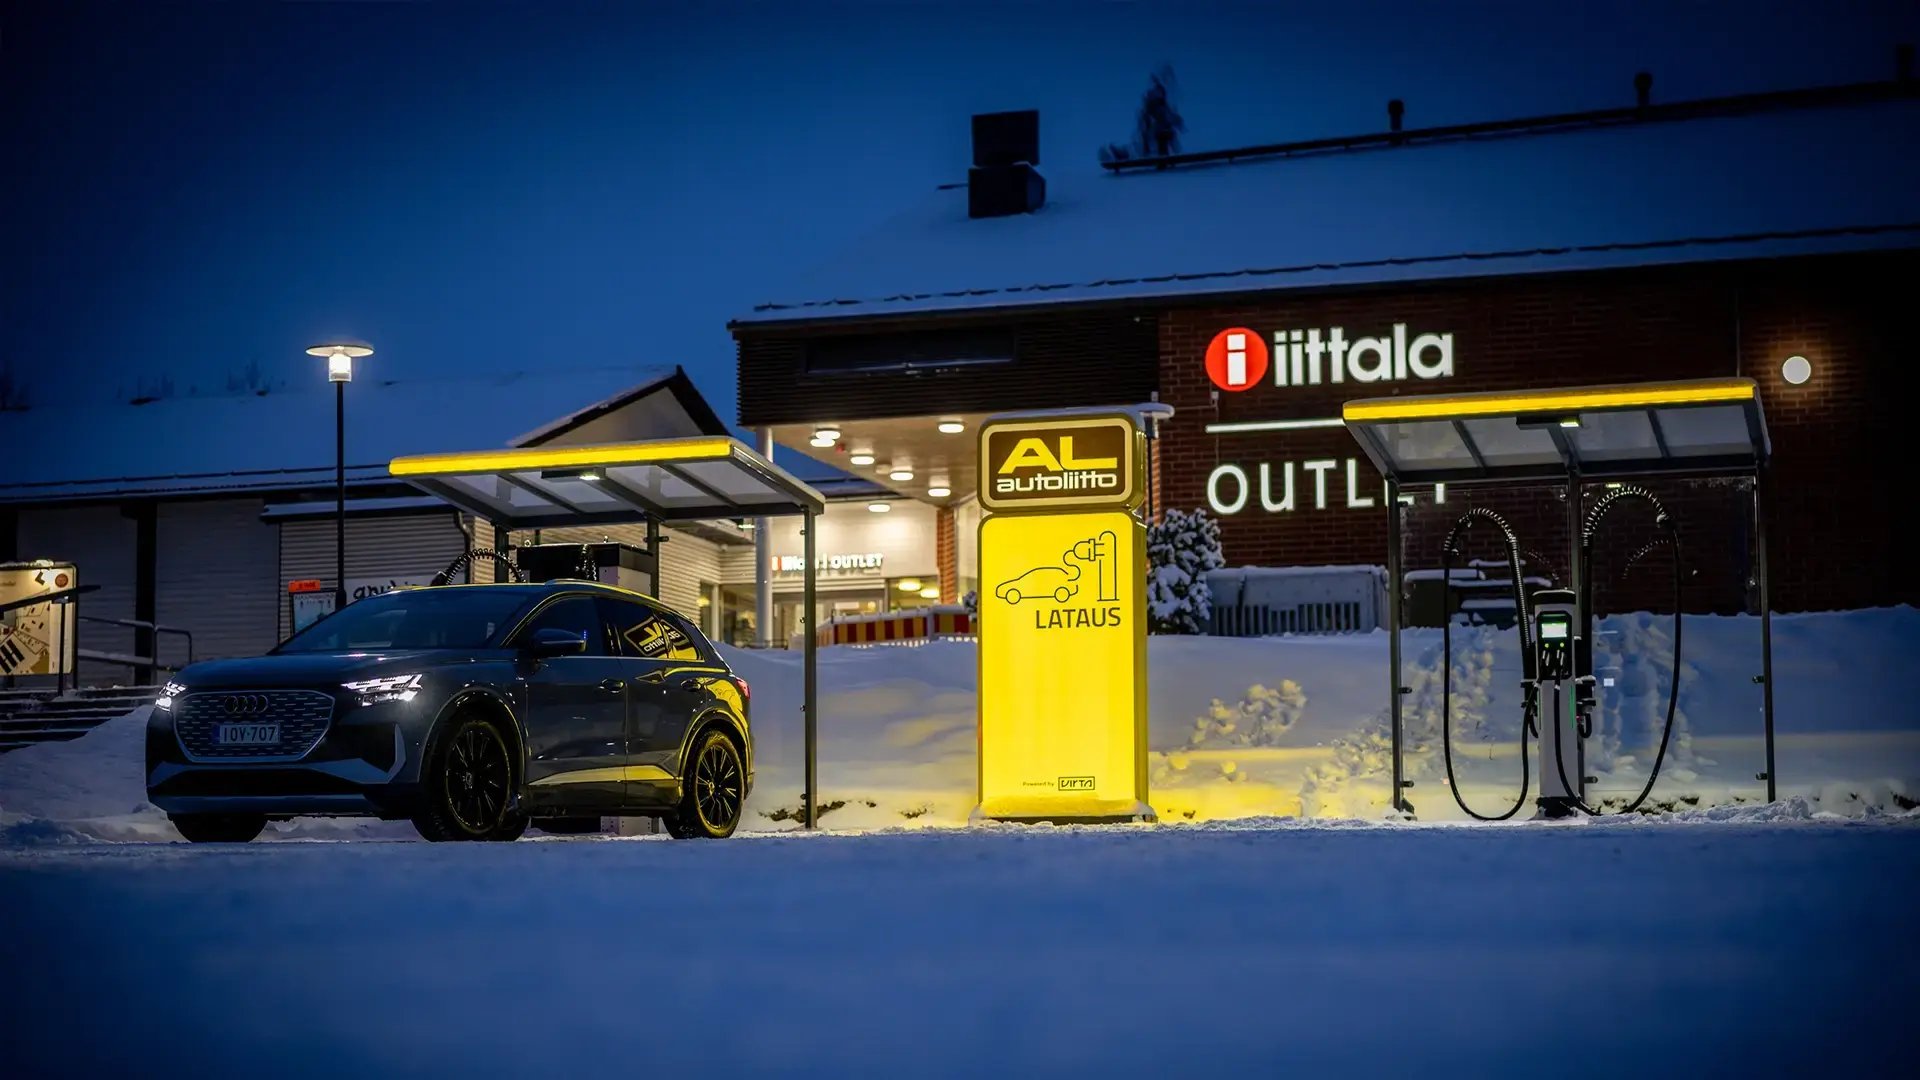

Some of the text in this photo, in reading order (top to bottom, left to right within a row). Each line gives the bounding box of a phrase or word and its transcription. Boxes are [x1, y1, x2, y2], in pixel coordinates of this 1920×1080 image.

[1273, 323, 1454, 387] iittala
[998, 436, 1118, 474] AL
[996, 470, 1117, 492] autoliitto
[1206, 458, 1446, 515] OUTL
[831, 553, 883, 569] OUTLET
[1036, 607, 1121, 629] LATAUS
[1060, 779, 1093, 788] VIRTA
